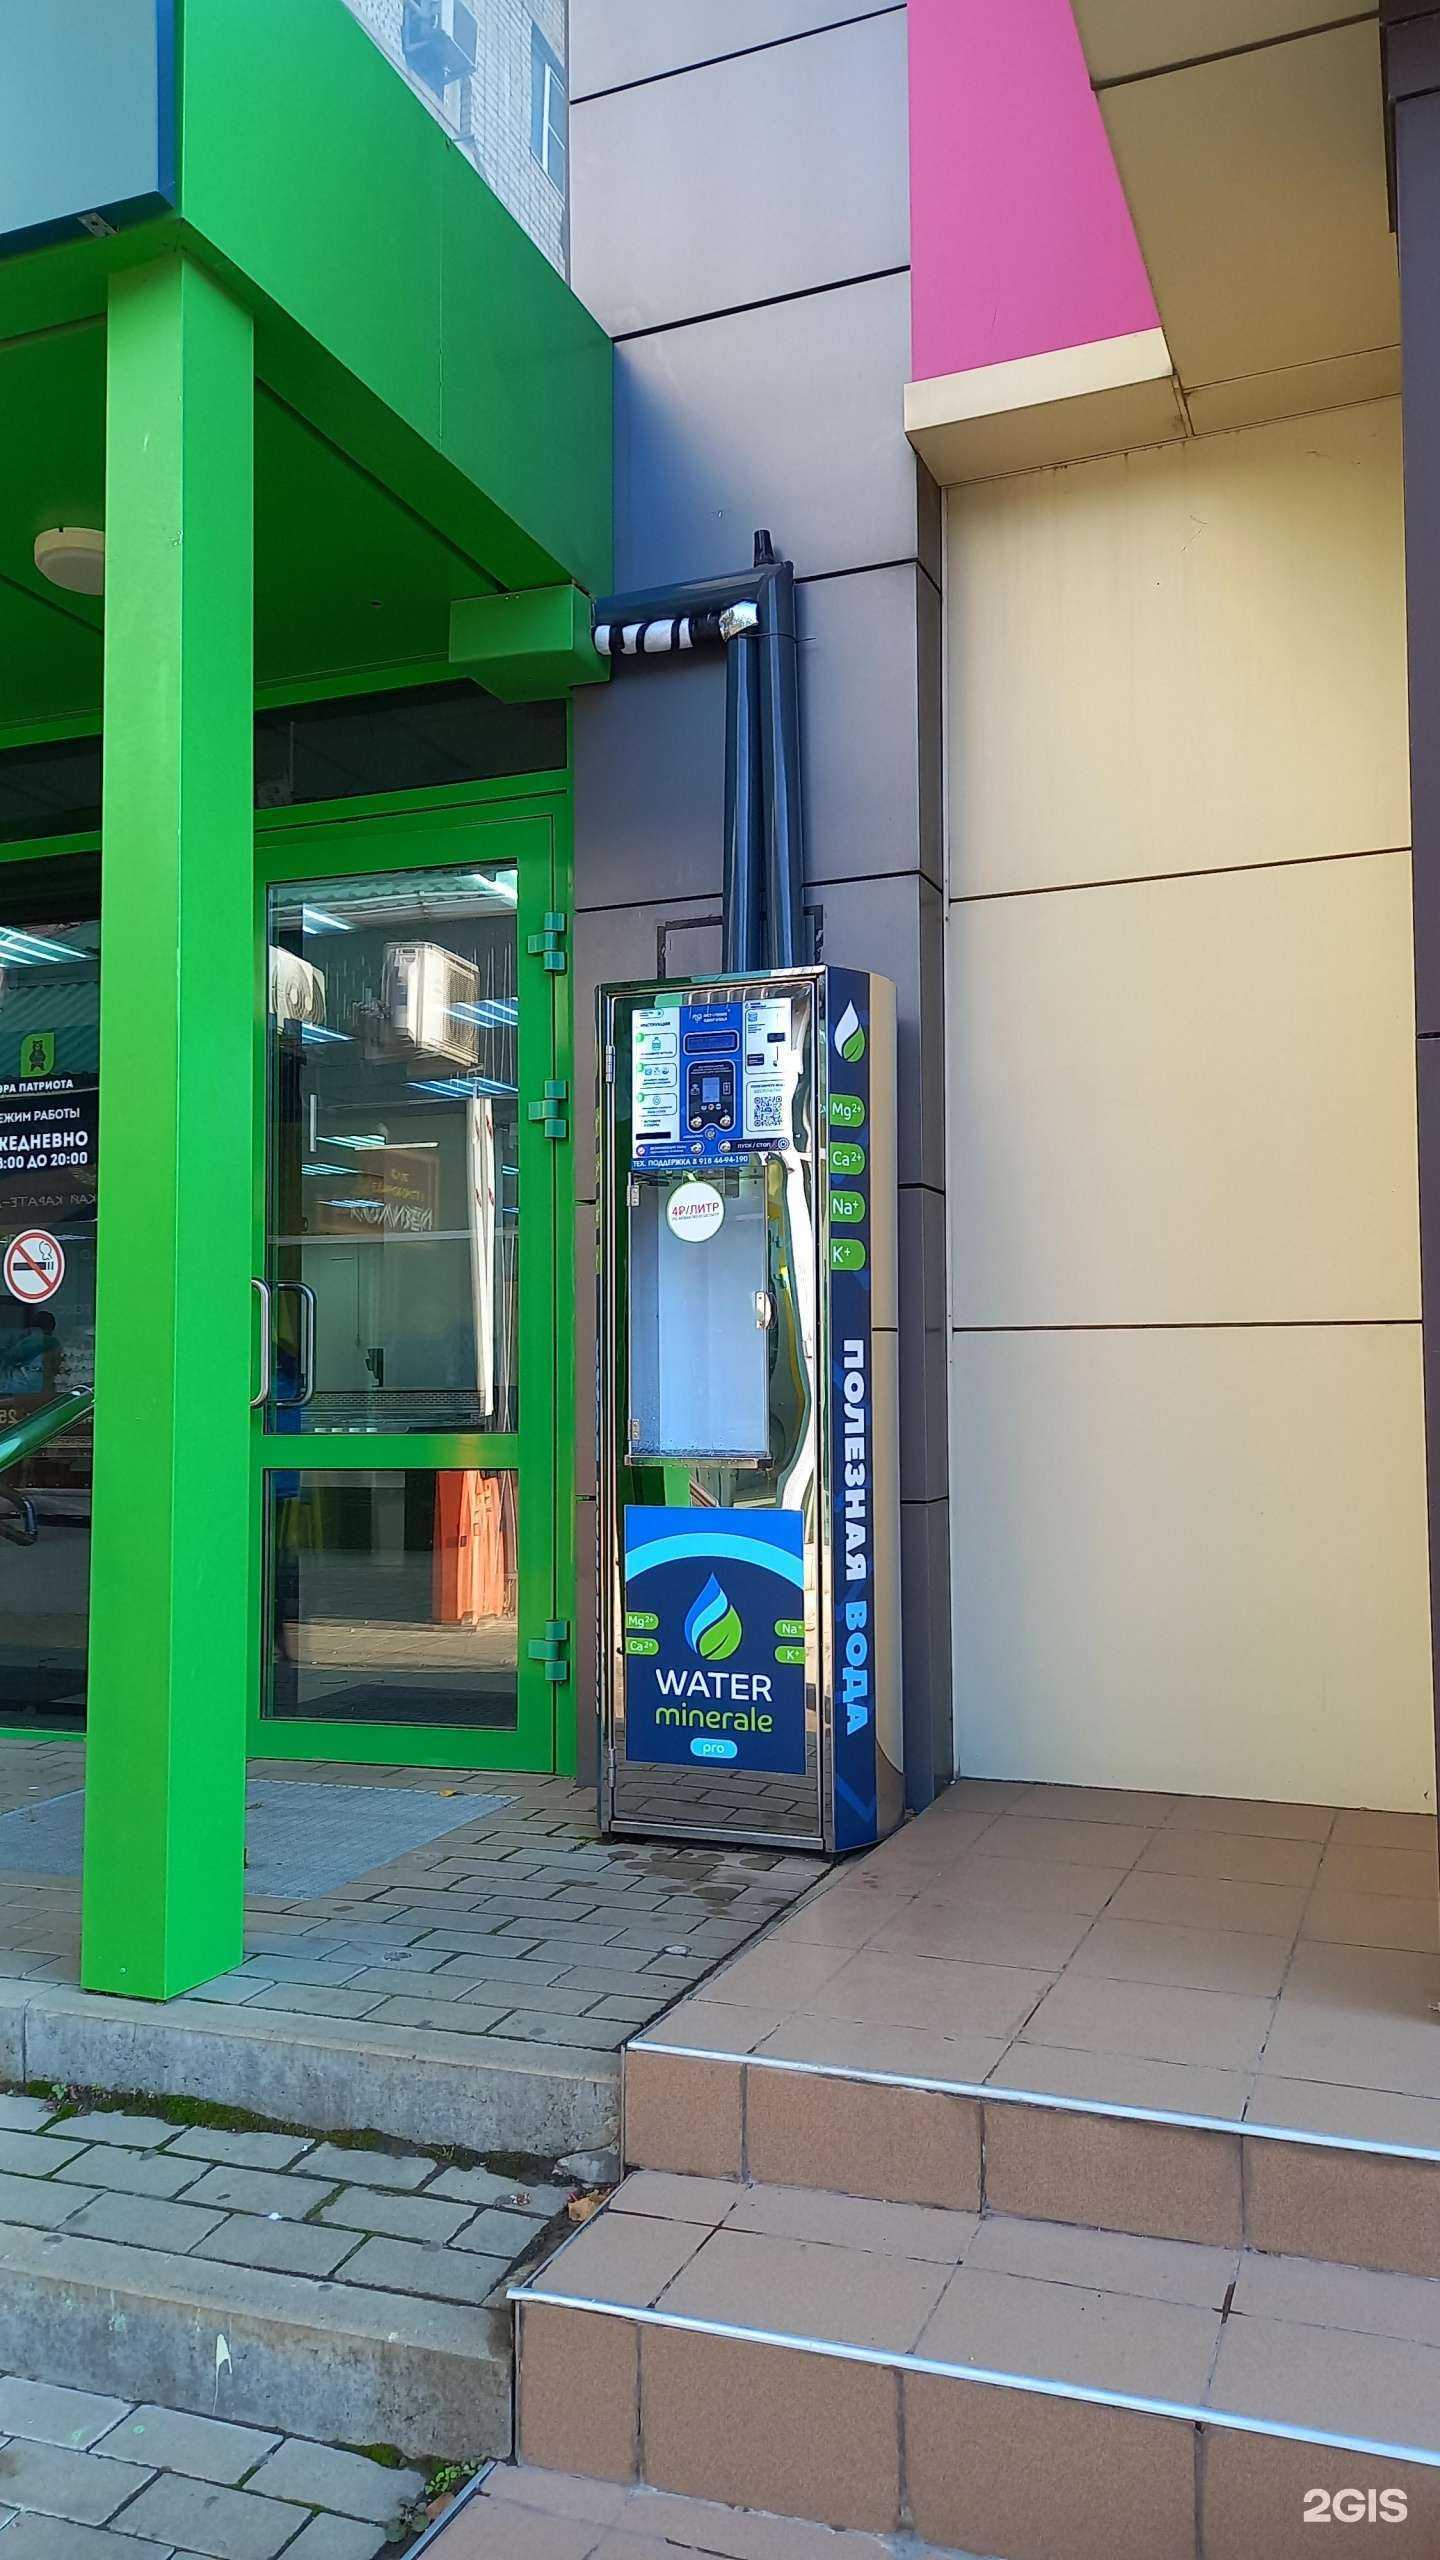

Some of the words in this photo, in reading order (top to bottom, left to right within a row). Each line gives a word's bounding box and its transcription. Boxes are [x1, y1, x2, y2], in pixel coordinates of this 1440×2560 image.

[19, 1079, 74, 1092] ПАТРИОТА
[34, 1107, 80, 1121] РАБОТЫ
[26, 1154, 48, 1169] ДО
[50, 1152, 88, 1167] 20:00
[648, 1158, 691, 1168] ПОДДЕРЖКА
[699, 1157, 712, 1165] 918
[842, 1339, 869, 1582] ПОЛЕЗНАЯ
[842, 1600, 870, 1737] ВОДА
[655, 1668, 773, 1702] WATER
[655, 1702, 773, 1733] minerale
[702, 1742, 725, 1755] pro
